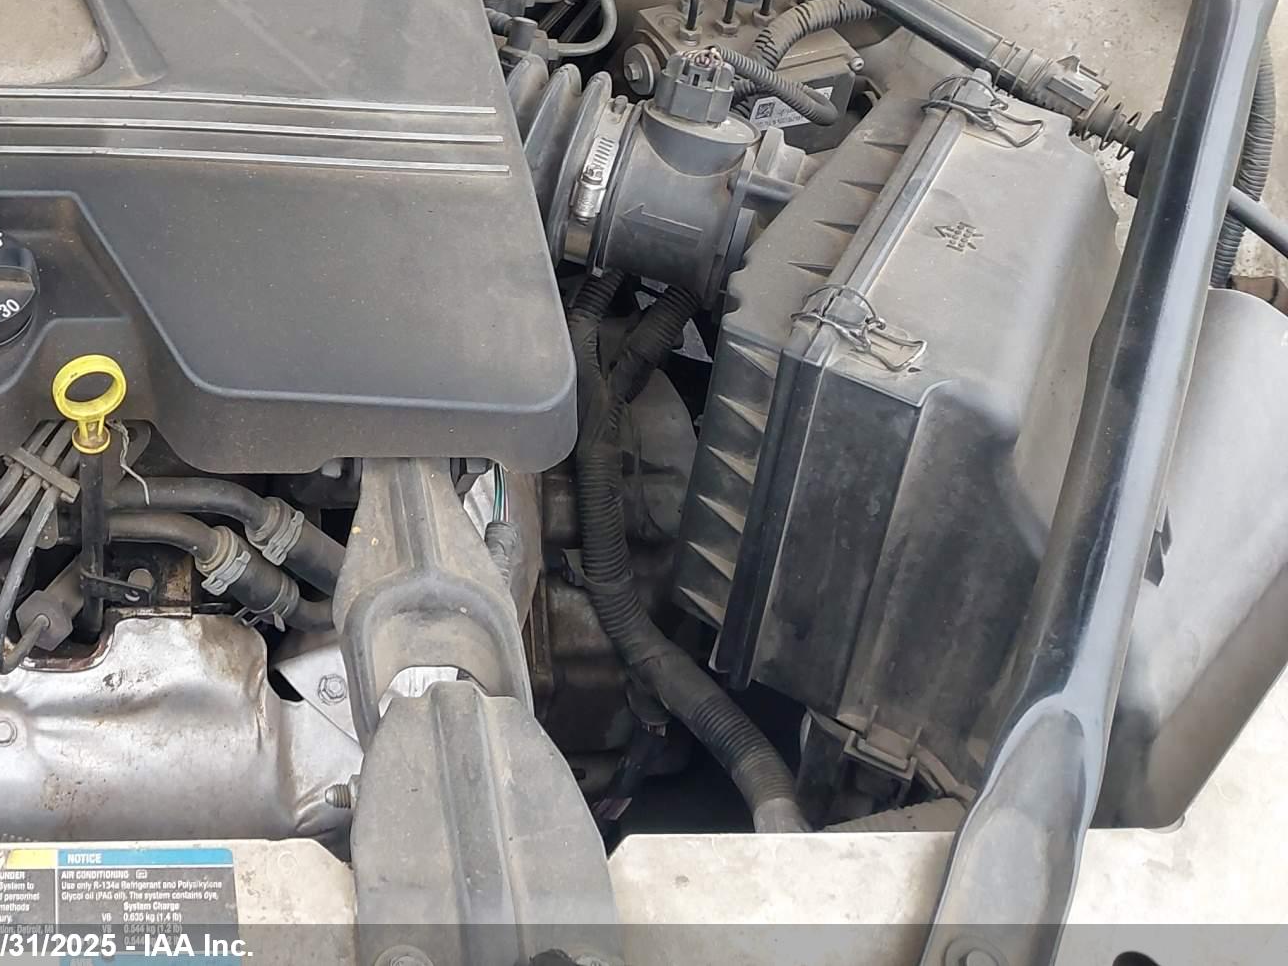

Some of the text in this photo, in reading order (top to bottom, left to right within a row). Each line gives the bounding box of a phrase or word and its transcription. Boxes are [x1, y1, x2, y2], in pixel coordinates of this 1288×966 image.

[67, 853, 103, 864] NOTICE
[0, 871, 25, 880] UNDER
[61, 870, 129, 879] AIR CONDITIONING
[26, 882, 34, 890] to
[62, 881, 75, 890] Use
[77, 881, 90, 891] only
[93, 881, 120, 890] R-134a
[121, 881, 162, 891] Refrigerant
[163, 881, 176, 889] and
[4, 893, 40, 903] personnel
[62, 892, 83, 902] Glycol
[84, 892, 94, 900] oil
[96, 892, 113, 902] (PAG
[129, 892, 143, 900] The
[144, 892, 170, 902] system
[172, 891, 202, 900] contains
[123, 902, 180, 912] System Charge
[145, 912, 156, 923] kg
